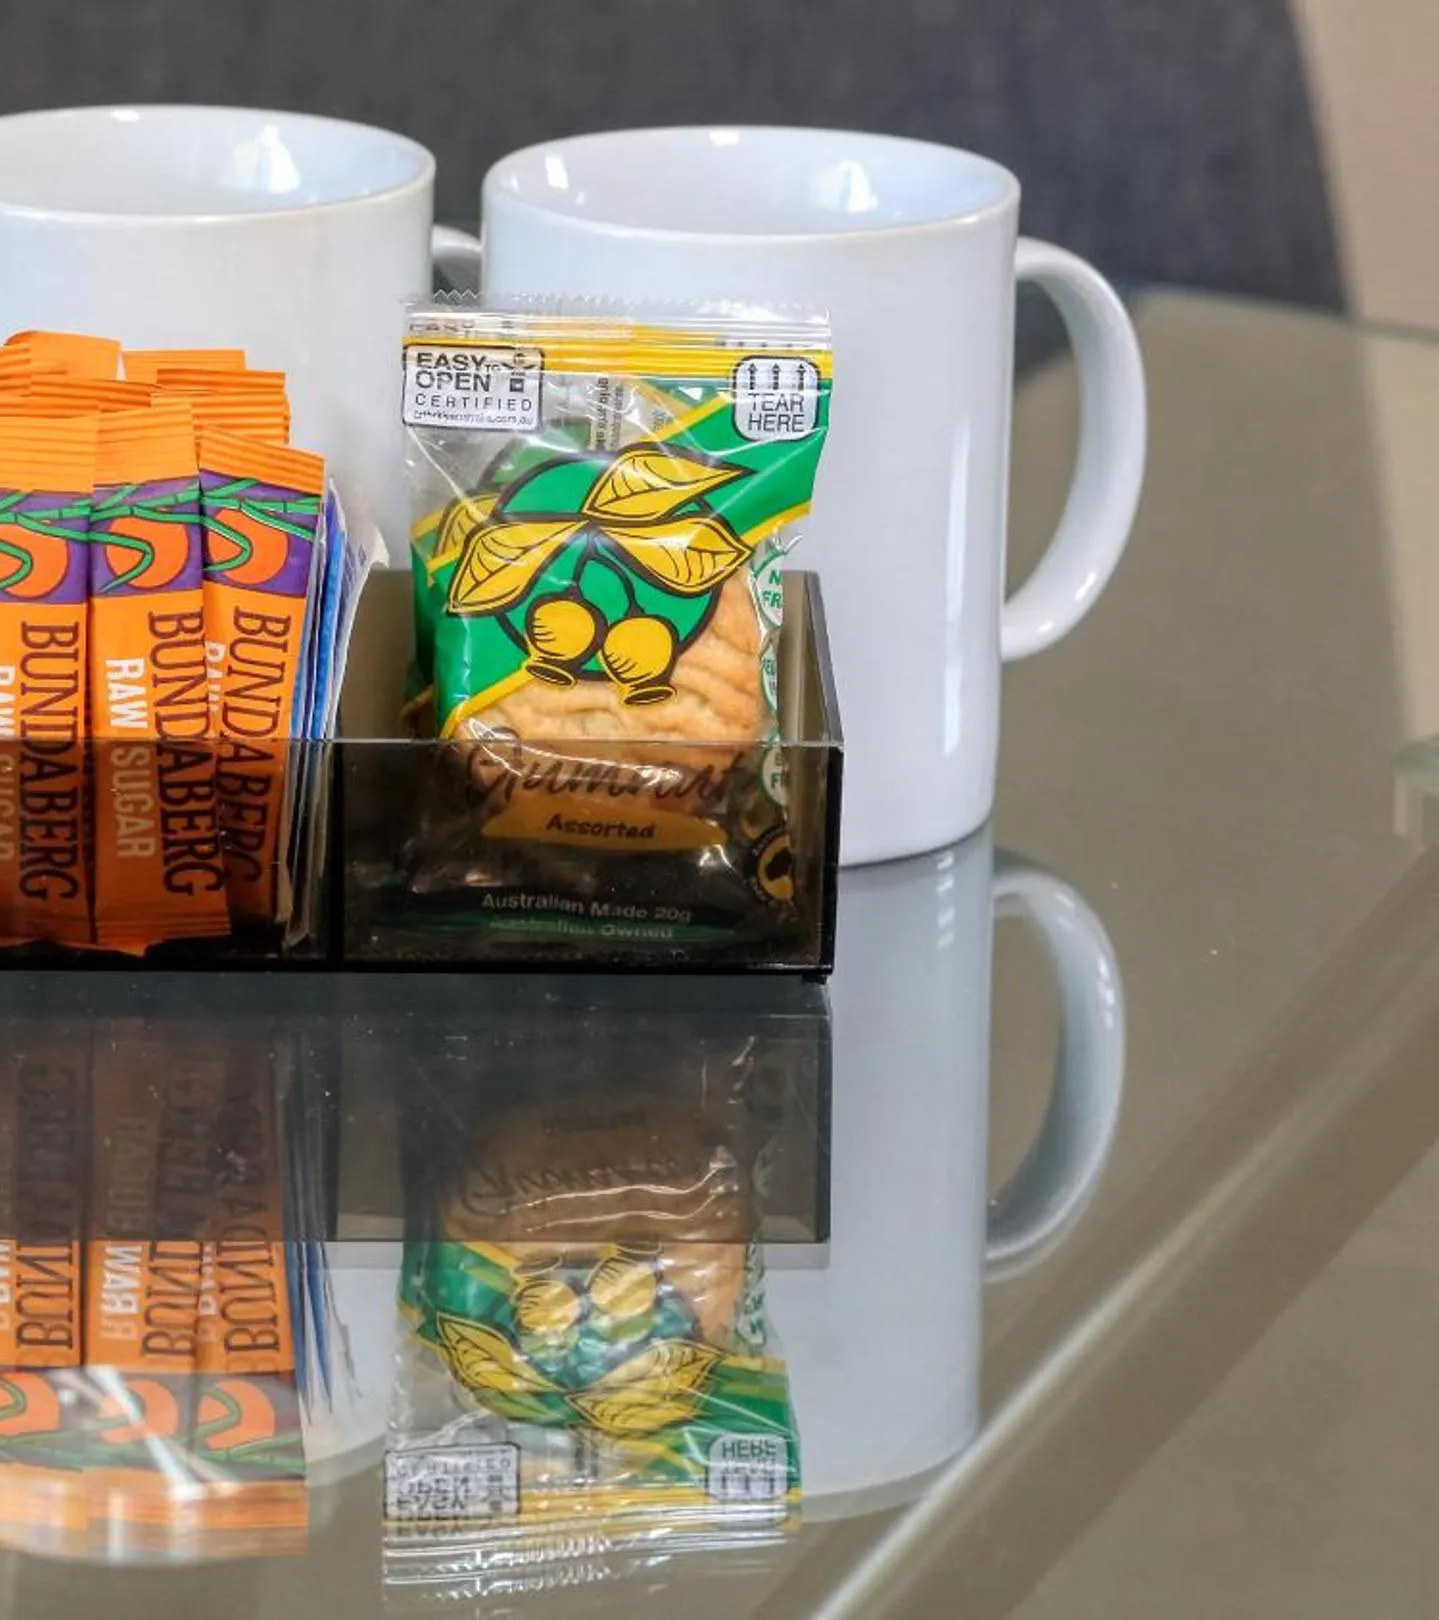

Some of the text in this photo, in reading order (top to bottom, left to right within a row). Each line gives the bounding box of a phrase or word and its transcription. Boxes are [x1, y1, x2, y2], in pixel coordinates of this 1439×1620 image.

[416, 352, 486, 371] EASY
[415, 370, 491, 392] OPEN
[415, 393, 533, 412] CERTIFIED
[748, 393, 803, 413] TEAR
[748, 413, 805, 433] HERE
[19, 620, 79, 900] BUNDABERG
[105, 658, 155, 857] RAW SUGAR
[148, 606, 224, 897] BUNDABERG
[546, 812, 656, 840] Assorted
[481, 892, 585, 914] Australian
[590, 900, 648, 920] Made
